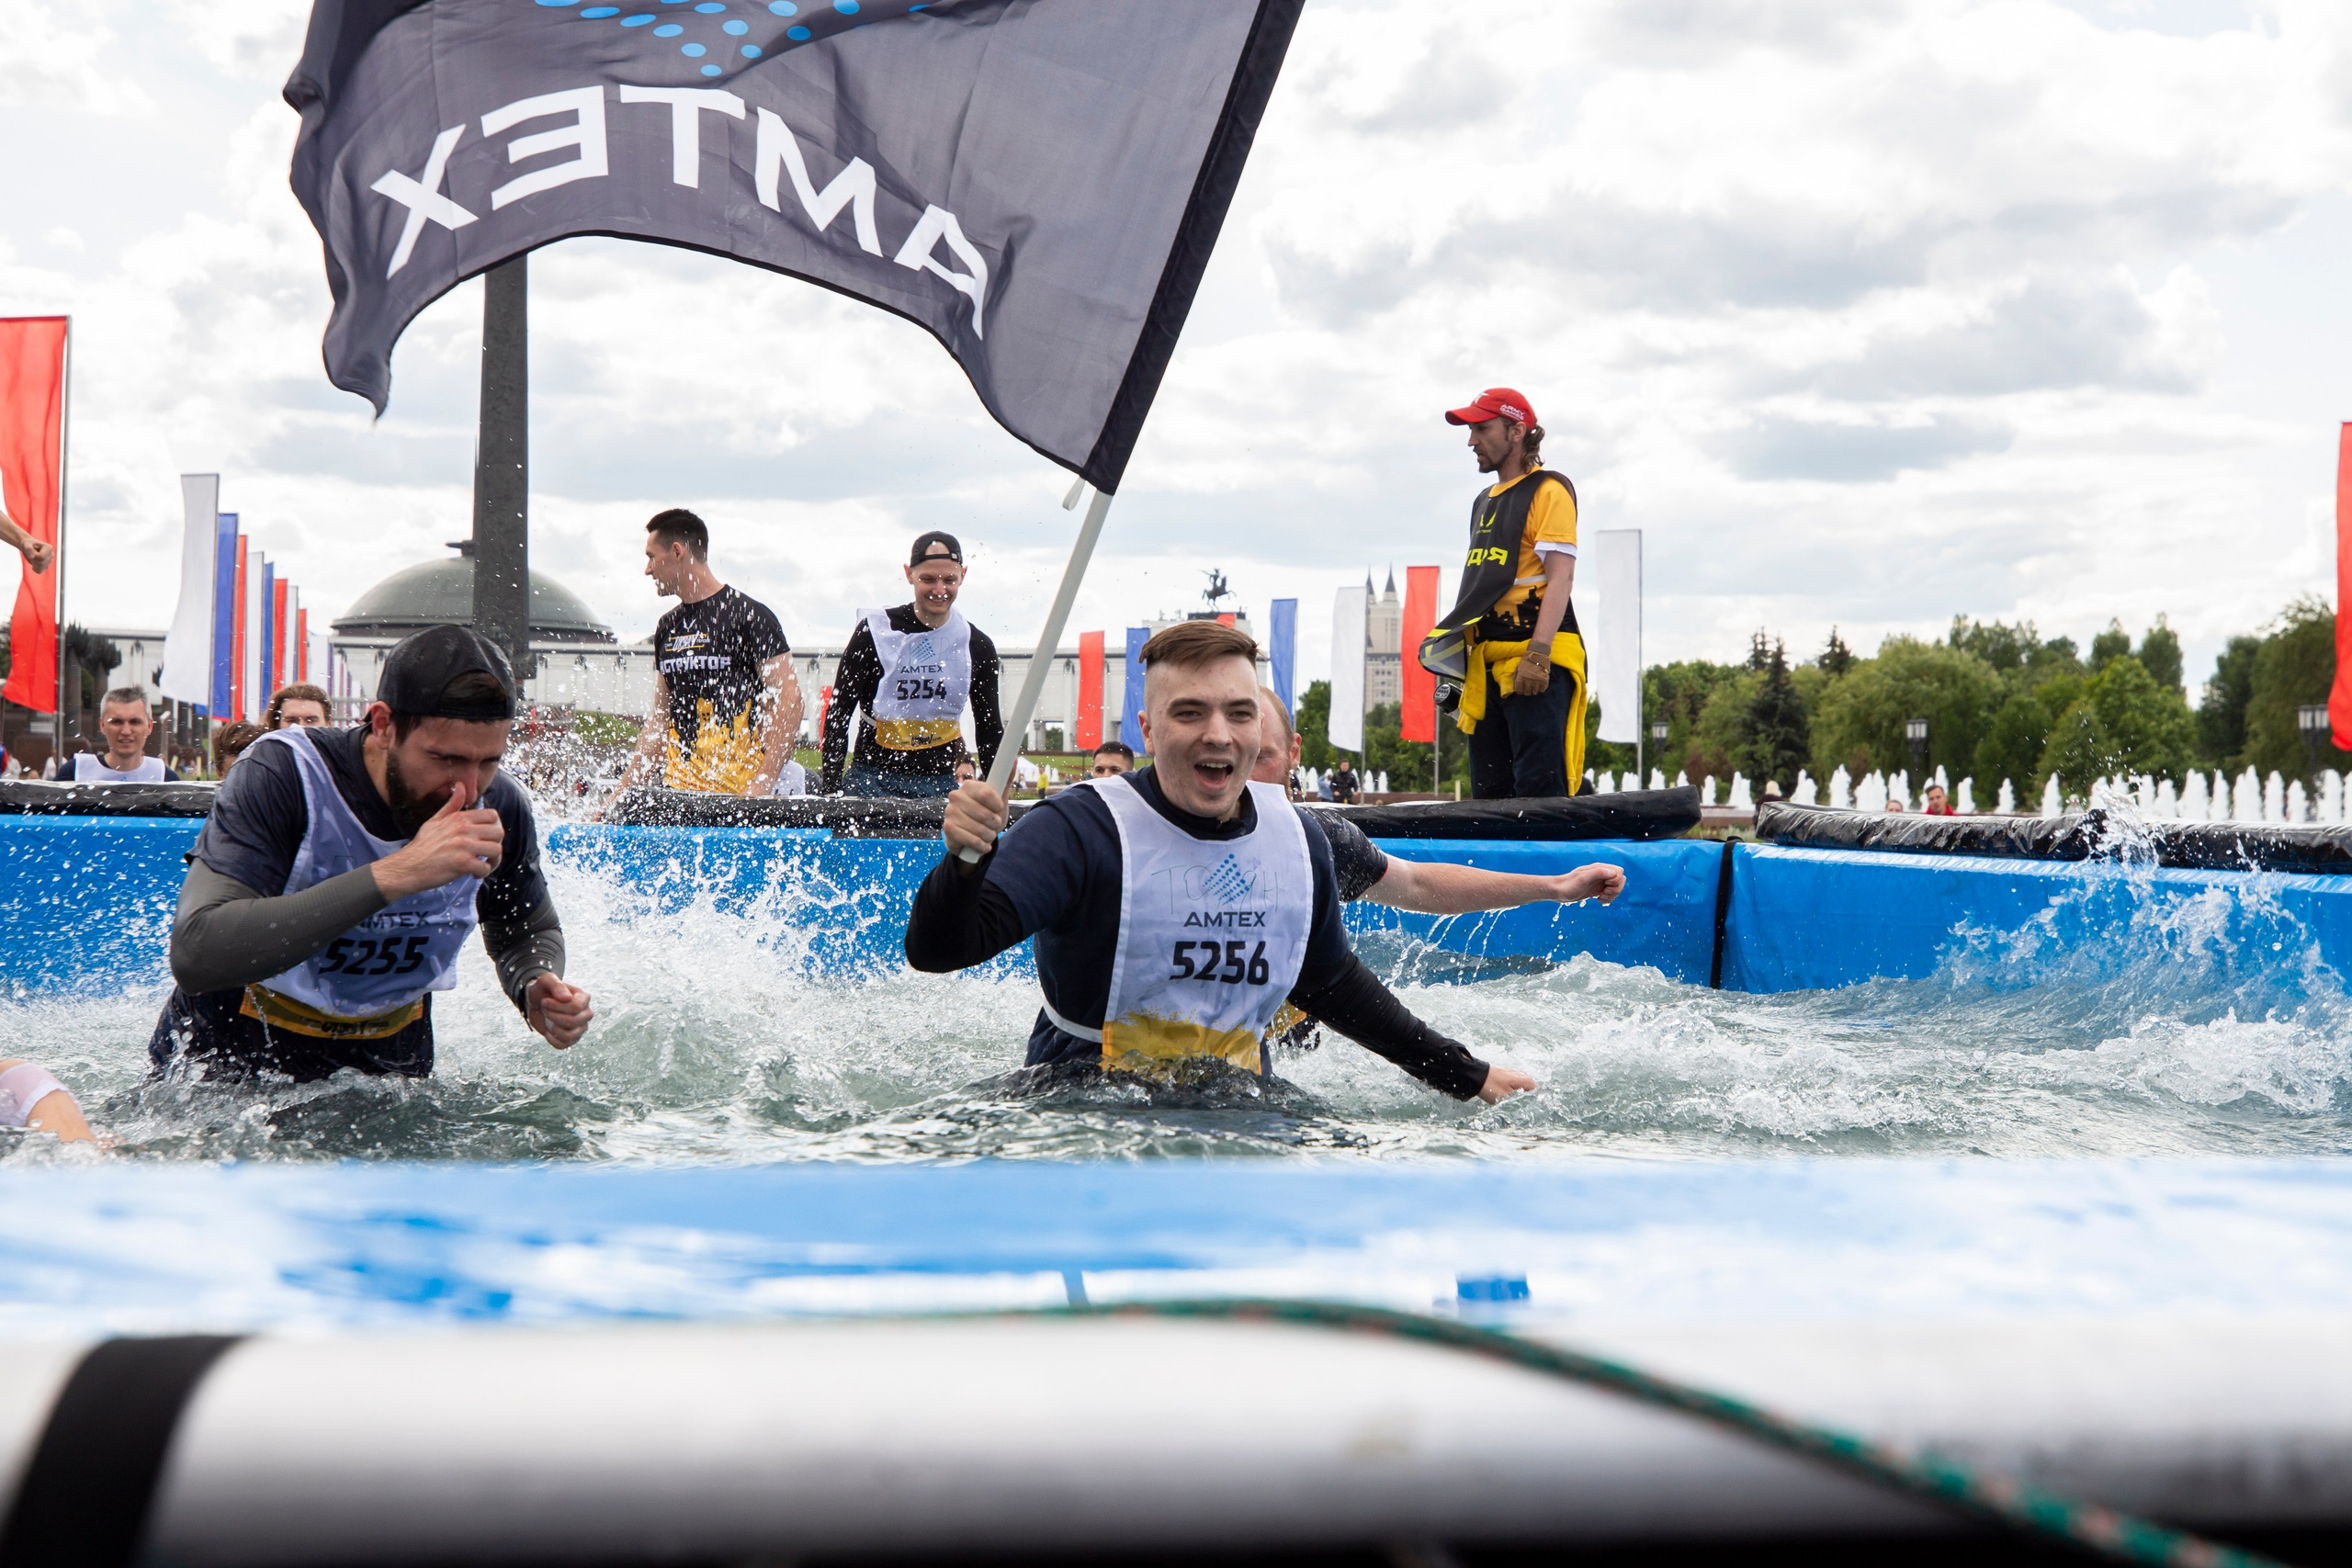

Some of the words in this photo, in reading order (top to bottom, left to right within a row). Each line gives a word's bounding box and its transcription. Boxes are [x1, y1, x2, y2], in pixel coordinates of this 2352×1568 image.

[900, 665, 944, 674] AMTEX
[897, 679, 947, 701] 5254
[359, 910, 430, 930] MTEX
[1183, 911, 1266, 928] AMTEX
[318, 936, 430, 976] 5255
[1169, 941, 1269, 986] 5256
